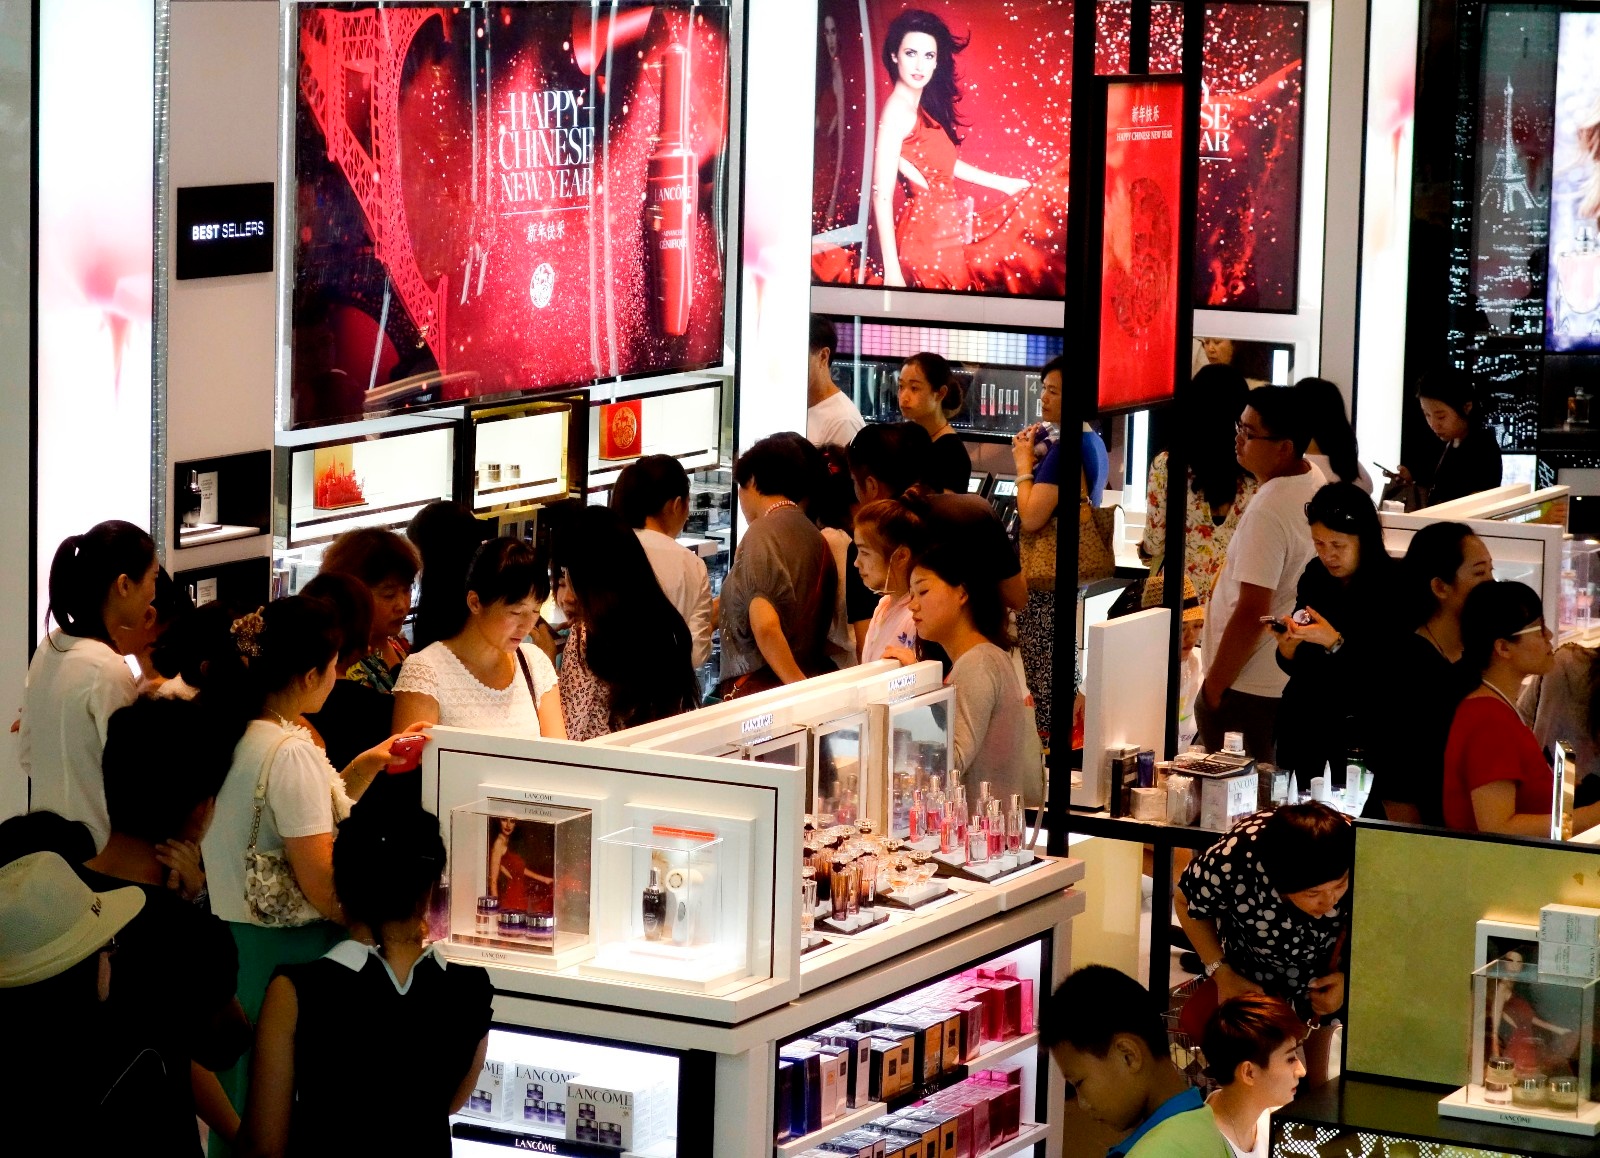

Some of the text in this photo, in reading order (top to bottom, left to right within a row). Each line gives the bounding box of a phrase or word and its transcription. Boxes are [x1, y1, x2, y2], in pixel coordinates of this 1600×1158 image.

[508, 90, 584, 130] HAPPY
[1116, 130, 1172, 141] HAPPY CHINESE NEW YEAR
[499, 126, 594, 169] CHINESE
[500, 168, 593, 202] NEW YEAR
[192, 220, 264, 241] BEST SELLERS
[1029, 381, 1037, 395] 4
[567, 1085, 633, 1107] LANCÔME
[514, 1138, 557, 1153] LANCÔME
